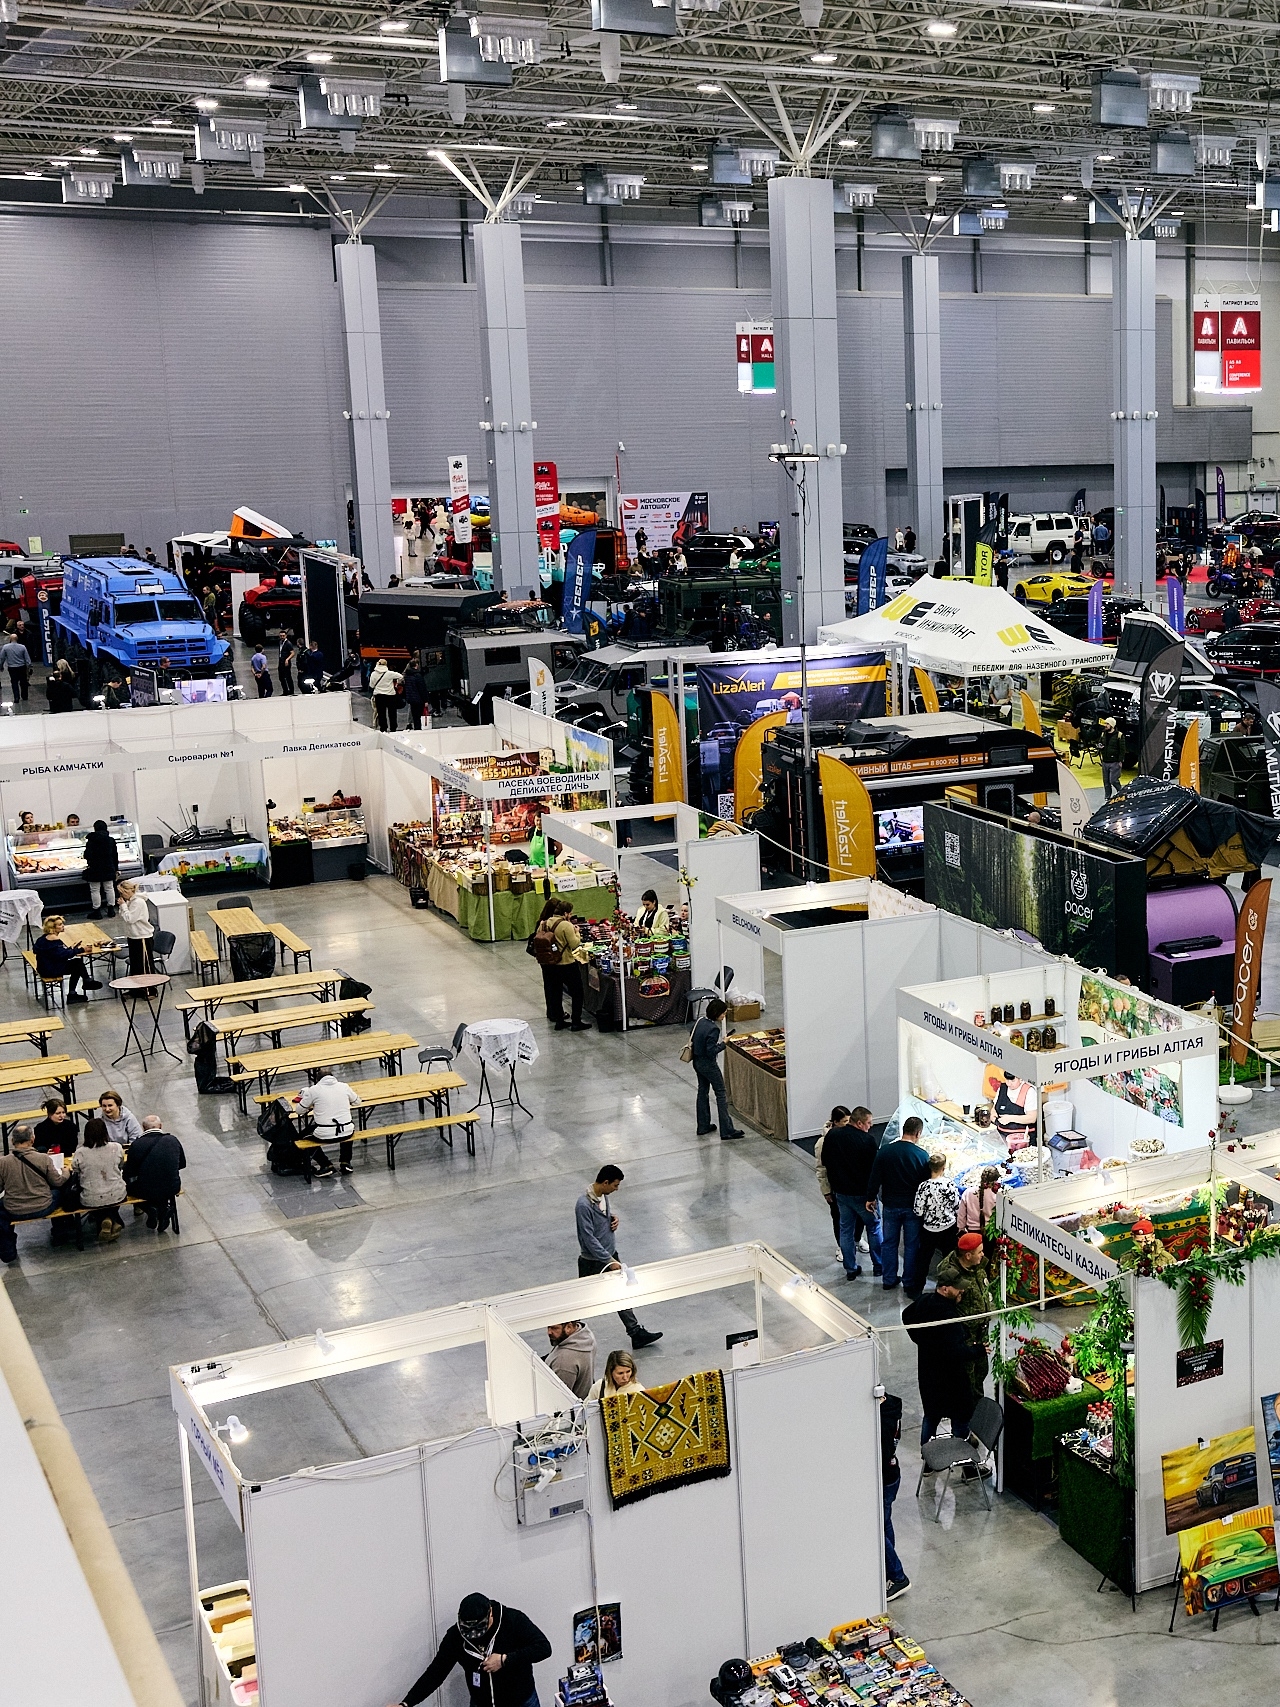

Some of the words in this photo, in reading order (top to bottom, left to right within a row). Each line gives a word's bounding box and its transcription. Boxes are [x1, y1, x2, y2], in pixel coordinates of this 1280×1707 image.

[573, 554, 585, 607] СЕВЕР
[868, 565, 878, 613] ЕВЕР
[972, 664, 1005, 673] ЛЕБЕДКИ
[1008, 663, 1023, 671] ДЛЯ
[1026, 659, 1067, 670] НАЗЕМНОГО
[1071, 654, 1116, 666] ТРАНСПОРТА
[712, 678, 766, 695] LizaAlert
[283, 744, 306, 753] Лавка
[308, 740, 361, 751] Деликатесов
[1162, 707, 1178, 783] OMENTUM
[168, 753, 218, 763] Сыроварня
[219, 750, 234, 759] №1
[22, 765, 51, 775] РЫБА
[53, 761, 104, 773] КАМЧАТКИ
[479, 765, 533, 780] TESS-DICH.ru
[853, 764, 888, 775] ТИВНЫЙ
[890, 762, 912, 772] ШТАБ
[498, 778, 535, 789] ПАСЕКА
[536, 772, 600, 785] ВОЕВОДИНЫХ
[509, 784, 563, 797] ДЕЛИКАТЕС
[564, 781, 590, 792] ДИЧЬ
[1064, 900, 1094, 920] pacer
[1233, 933, 1256, 1027] pacer
[922, 1010, 948, 1033] ЯГОДЫ
[948, 1022, 954, 1036] И
[954, 1026, 979, 1048] ГРИБЫ
[979, 1038, 1004, 1060] АЛТАЯ
[1053, 1055, 1100, 1075] ЯГОДЫ
[1103, 1052, 1113, 1065] И
[1115, 1045, 1160, 1063] ГРИБЫ
[1163, 1036, 1204, 1055] АЛТАЯ
[1009, 1213, 1074, 1263] ДЕЛИКАТЕСЫ
